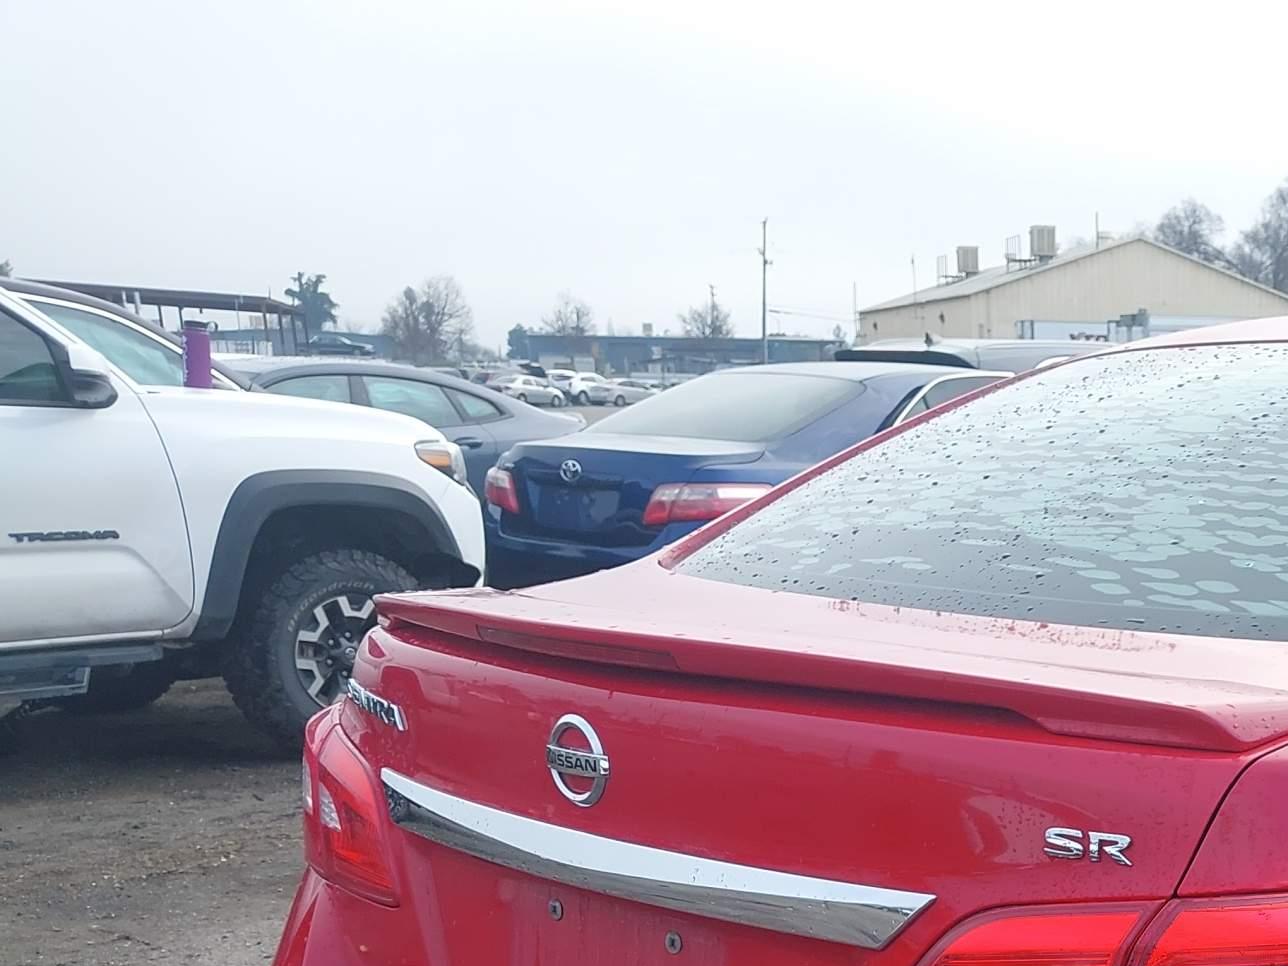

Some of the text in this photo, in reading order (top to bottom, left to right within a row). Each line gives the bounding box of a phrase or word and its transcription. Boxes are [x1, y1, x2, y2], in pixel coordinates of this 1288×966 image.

[8, 530, 120, 543] TACOMA
[547, 747, 598, 774] NISSAN
[1043, 827, 1133, 867] SR
